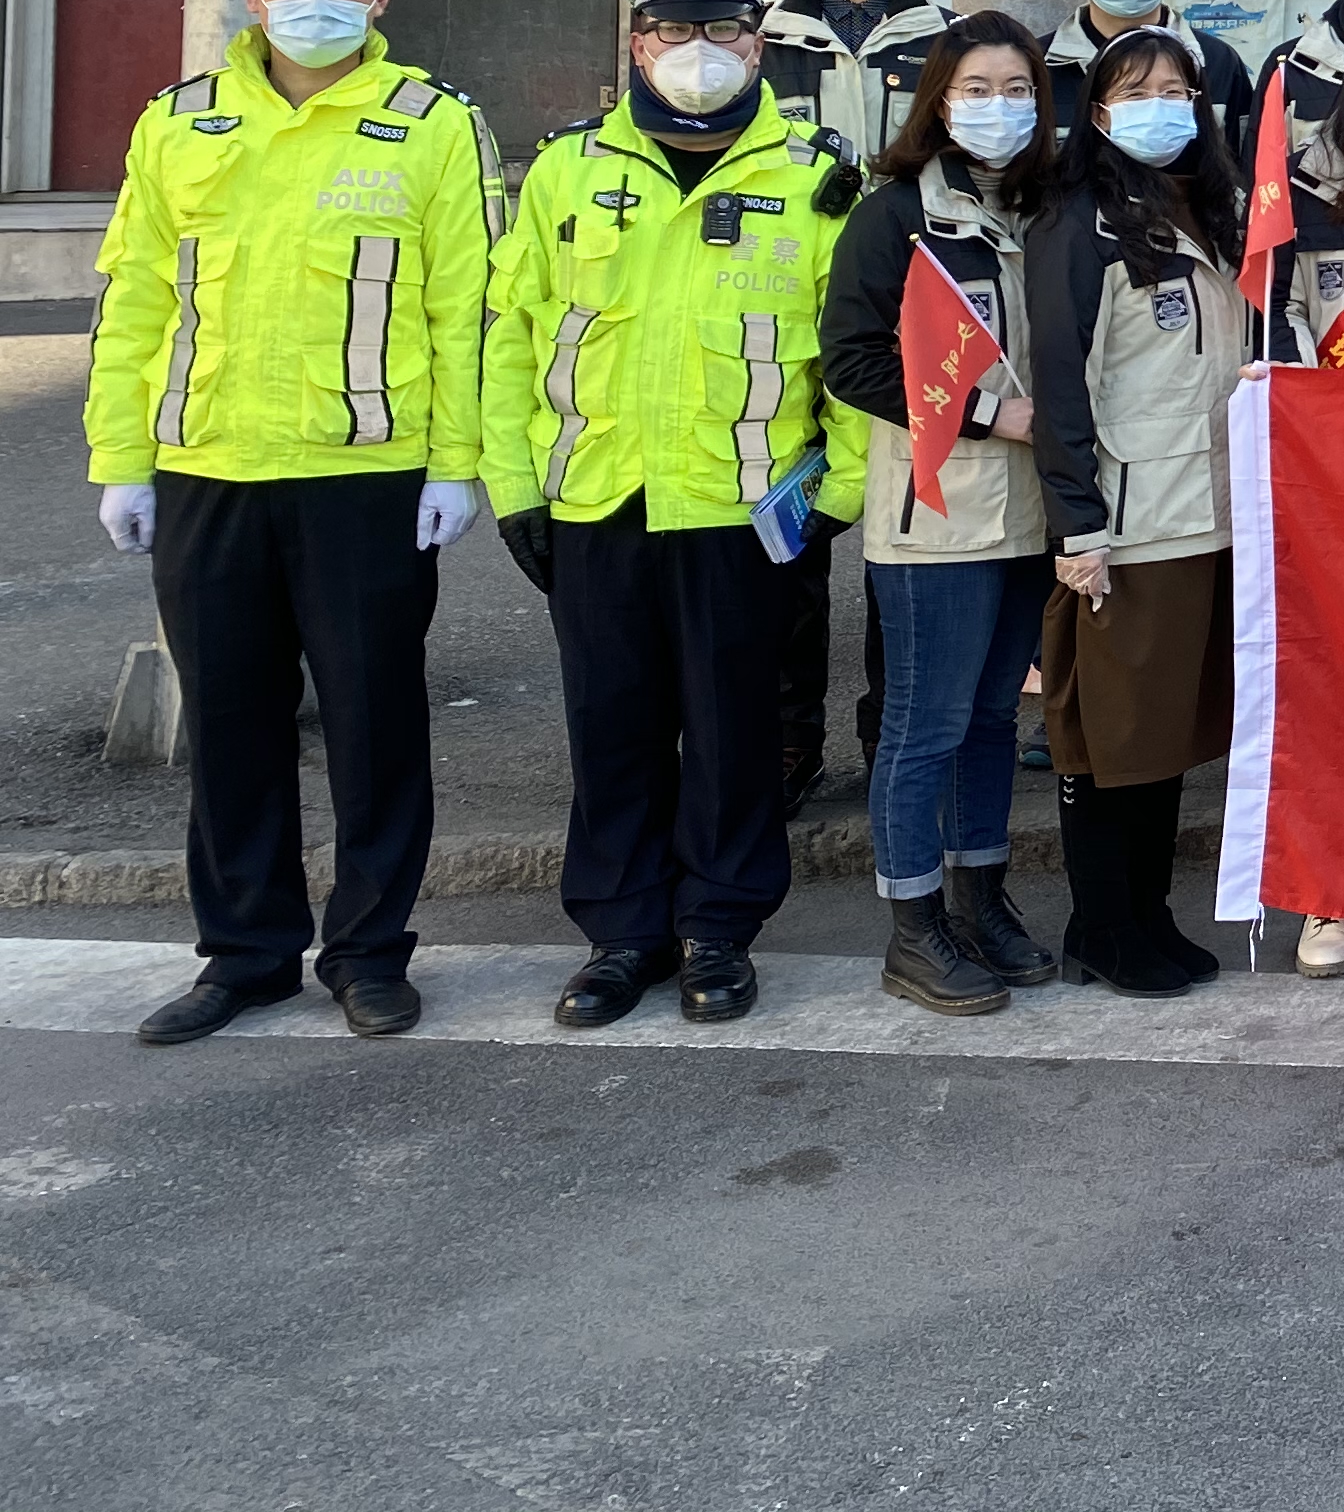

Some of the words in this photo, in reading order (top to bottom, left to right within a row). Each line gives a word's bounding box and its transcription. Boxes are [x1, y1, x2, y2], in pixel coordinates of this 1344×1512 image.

[360, 122, 405, 139] SN0555
[332, 168, 404, 192] AUX
[316, 191, 408, 217] POLICE
[715, 270, 801, 294] POLICE
